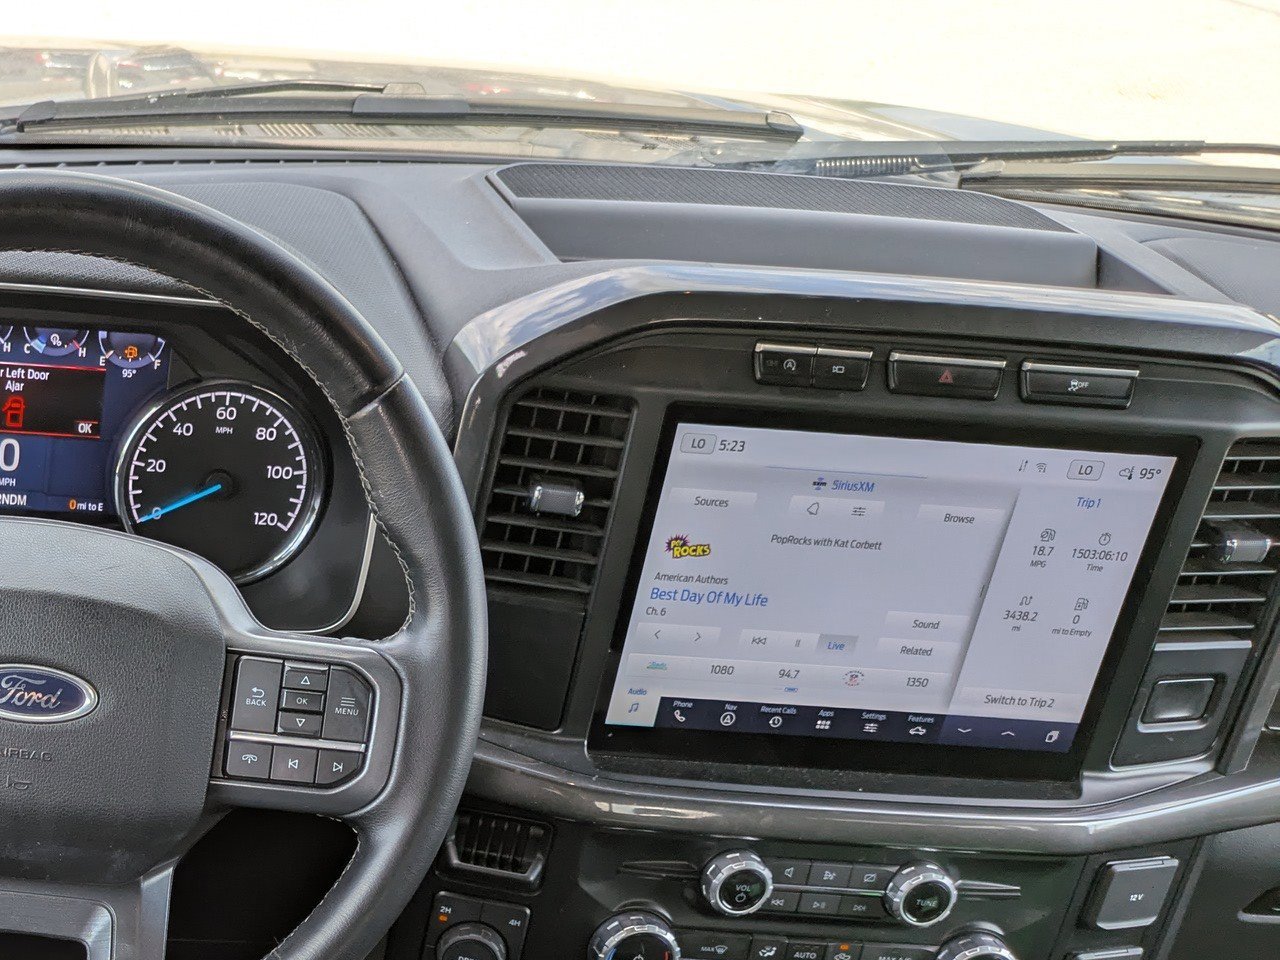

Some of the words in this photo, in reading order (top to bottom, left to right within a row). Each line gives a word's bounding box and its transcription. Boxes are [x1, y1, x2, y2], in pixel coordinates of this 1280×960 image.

[4, 342, 11, 352] H
[24, 344, 30, 354] C
[79, 347, 86, 358] H
[100, 356, 106, 366] E
[155, 360, 161, 370] F
[6, 367, 25, 379] Left
[28, 369, 50, 381] Door
[6, 380, 24, 392] Ajar
[216, 407, 237, 420] 60
[78, 423, 92, 434] OK
[173, 423, 193, 436] 40
[215, 426, 233, 435] MPH
[256, 428, 277, 441] 80
[691, 438, 706, 449] LO
[719, 439, 746, 452] 5:23
[0, 438, 20, 472] 0
[147, 460, 166, 473] 20
[267, 466, 293, 480] 100
[1078, 466, 1093, 475] LO
[1139, 468, 1162, 480] 95°
[832, 480, 875, 493] SiriusXM
[70, 499, 77, 510] 0
[77, 501, 87, 510] mi
[89, 503, 97, 511] to
[98, 503, 104, 512] E
[694, 496, 729, 508] Sources
[1077, 497, 1096, 509] Trip
[254, 512, 278, 526] 120
[944, 513, 975, 524] Browse
[771, 535, 812, 547] PopRocks
[814, 538, 832, 548] with
[833, 539, 849, 549] Kat
[850, 540, 882, 551] Corbett
[673, 544, 710, 558] ROCKS
[1032, 546, 1055, 556] 18.7
[1072, 548, 1128, 562] 1503:06:10
[1030, 560, 1047, 568] MPG
[1087, 564, 1104, 572] Time
[654, 572, 694, 583] American
[695, 575, 728, 585] Authors
[650, 588, 678, 601] Best
[681, 590, 705, 605] Day
[707, 591, 723, 604] Of
[724, 592, 743, 607] My
[745, 594, 768, 607] Life
[646, 607, 658, 616] Ch.
[661, 608, 667, 616] 6
[1003, 610, 1038, 622] 3438.2
[913, 619, 940, 629] Sound
[1073, 615, 1080, 624] 0
[1070, 629, 1093, 637] Empty
[828, 642, 845, 651] Live
[900, 646, 933, 656] Related
[711, 665, 735, 676] 1080
[779, 669, 800, 679] 94.7
[907, 677, 929, 688] 1350
[628, 688, 647, 696] Audio
[246, 698, 267, 707] BACK
[984, 695, 1015, 706] Switch
[1018, 697, 1027, 706] to
[1029, 698, 1047, 709] Trip
[1047, 699, 1055, 708] 2
[335, 708, 360, 716] MENU
[782, 707, 797, 715] Calls
[819, 710, 834, 718] Apps
[861, 713, 887, 721] Settings
[916, 900, 938, 908] TUNE
[440, 906, 452, 914] 2H
[794, 952, 816, 960] AUTO
